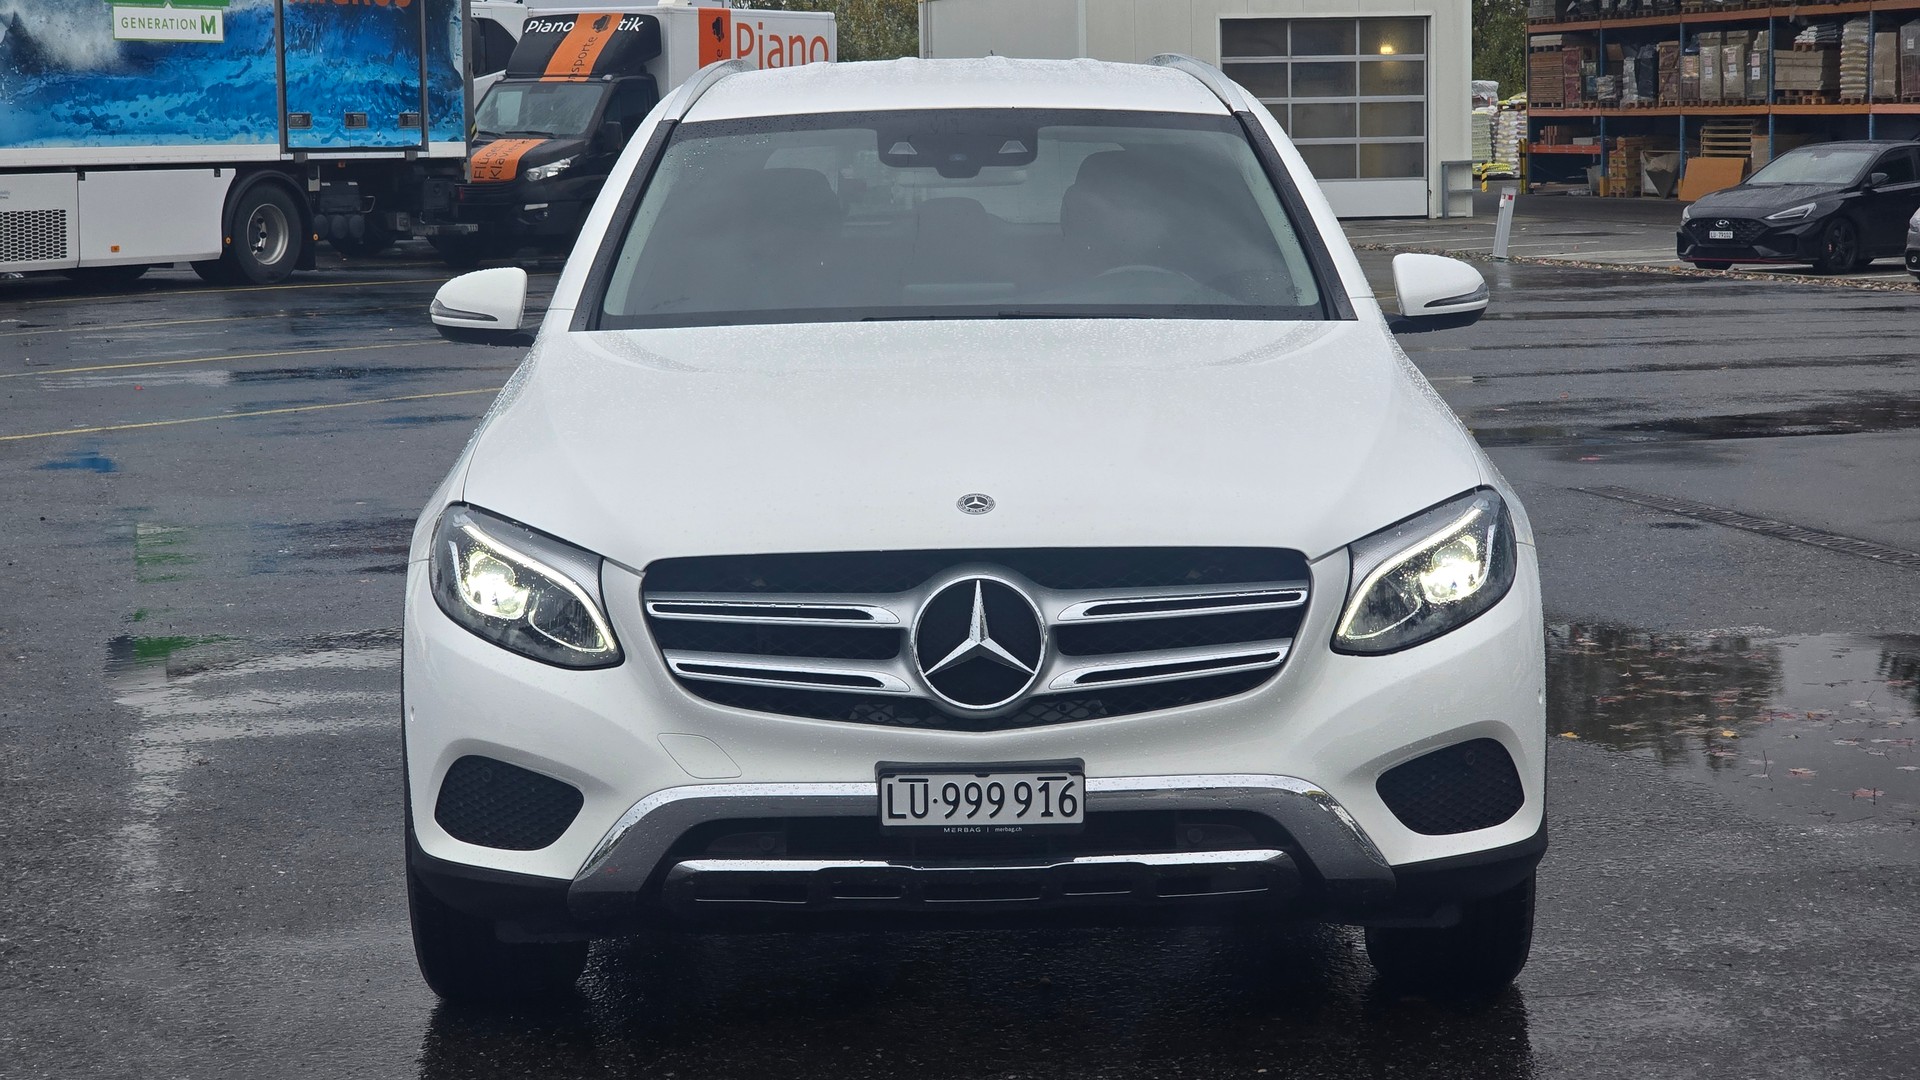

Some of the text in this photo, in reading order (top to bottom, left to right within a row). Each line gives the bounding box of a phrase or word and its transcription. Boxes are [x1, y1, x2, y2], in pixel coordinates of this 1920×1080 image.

[121, 15, 216, 34] GENERATION M
[525, 20, 575, 33] Piano
[736, 22, 829, 70] Piano
